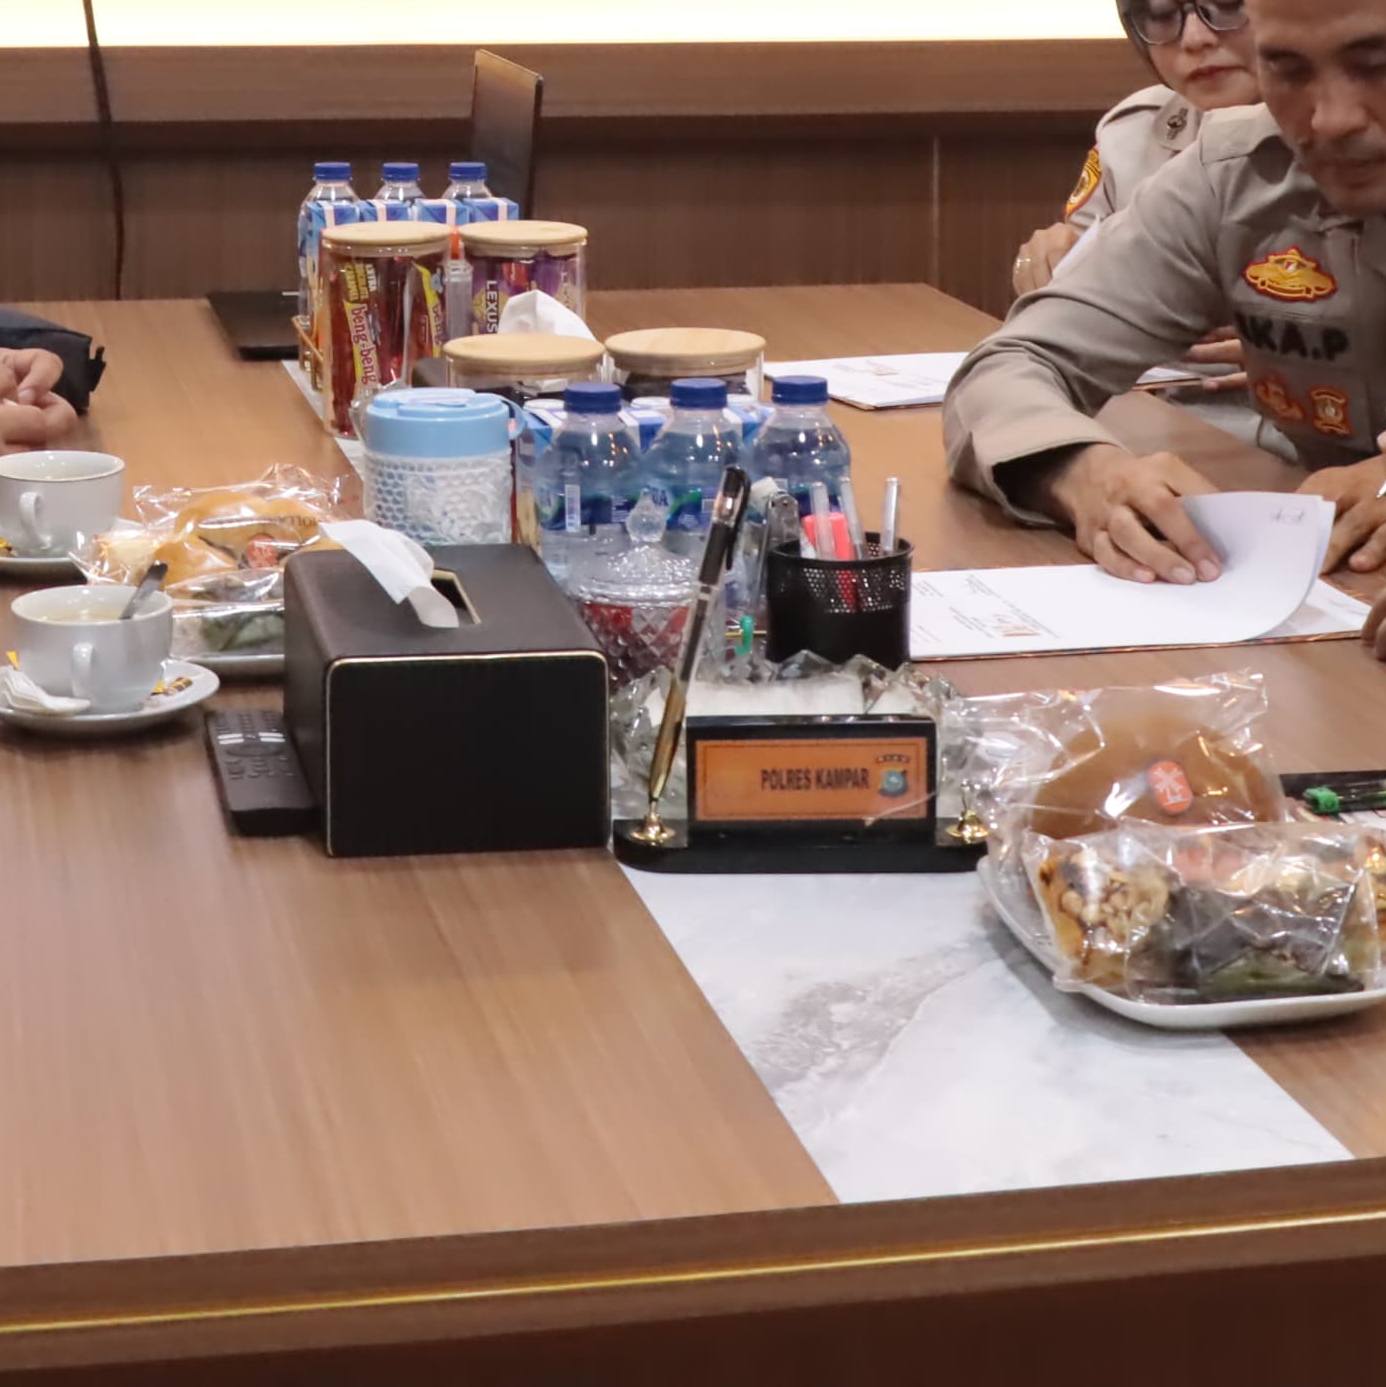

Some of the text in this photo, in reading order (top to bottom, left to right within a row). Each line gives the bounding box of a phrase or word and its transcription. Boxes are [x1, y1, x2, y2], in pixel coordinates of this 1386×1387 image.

[485, 280, 499, 333] LEXUS
[350, 305, 377, 385] beng-beng
[760, 766, 870, 791] POLRES KAMPAR
